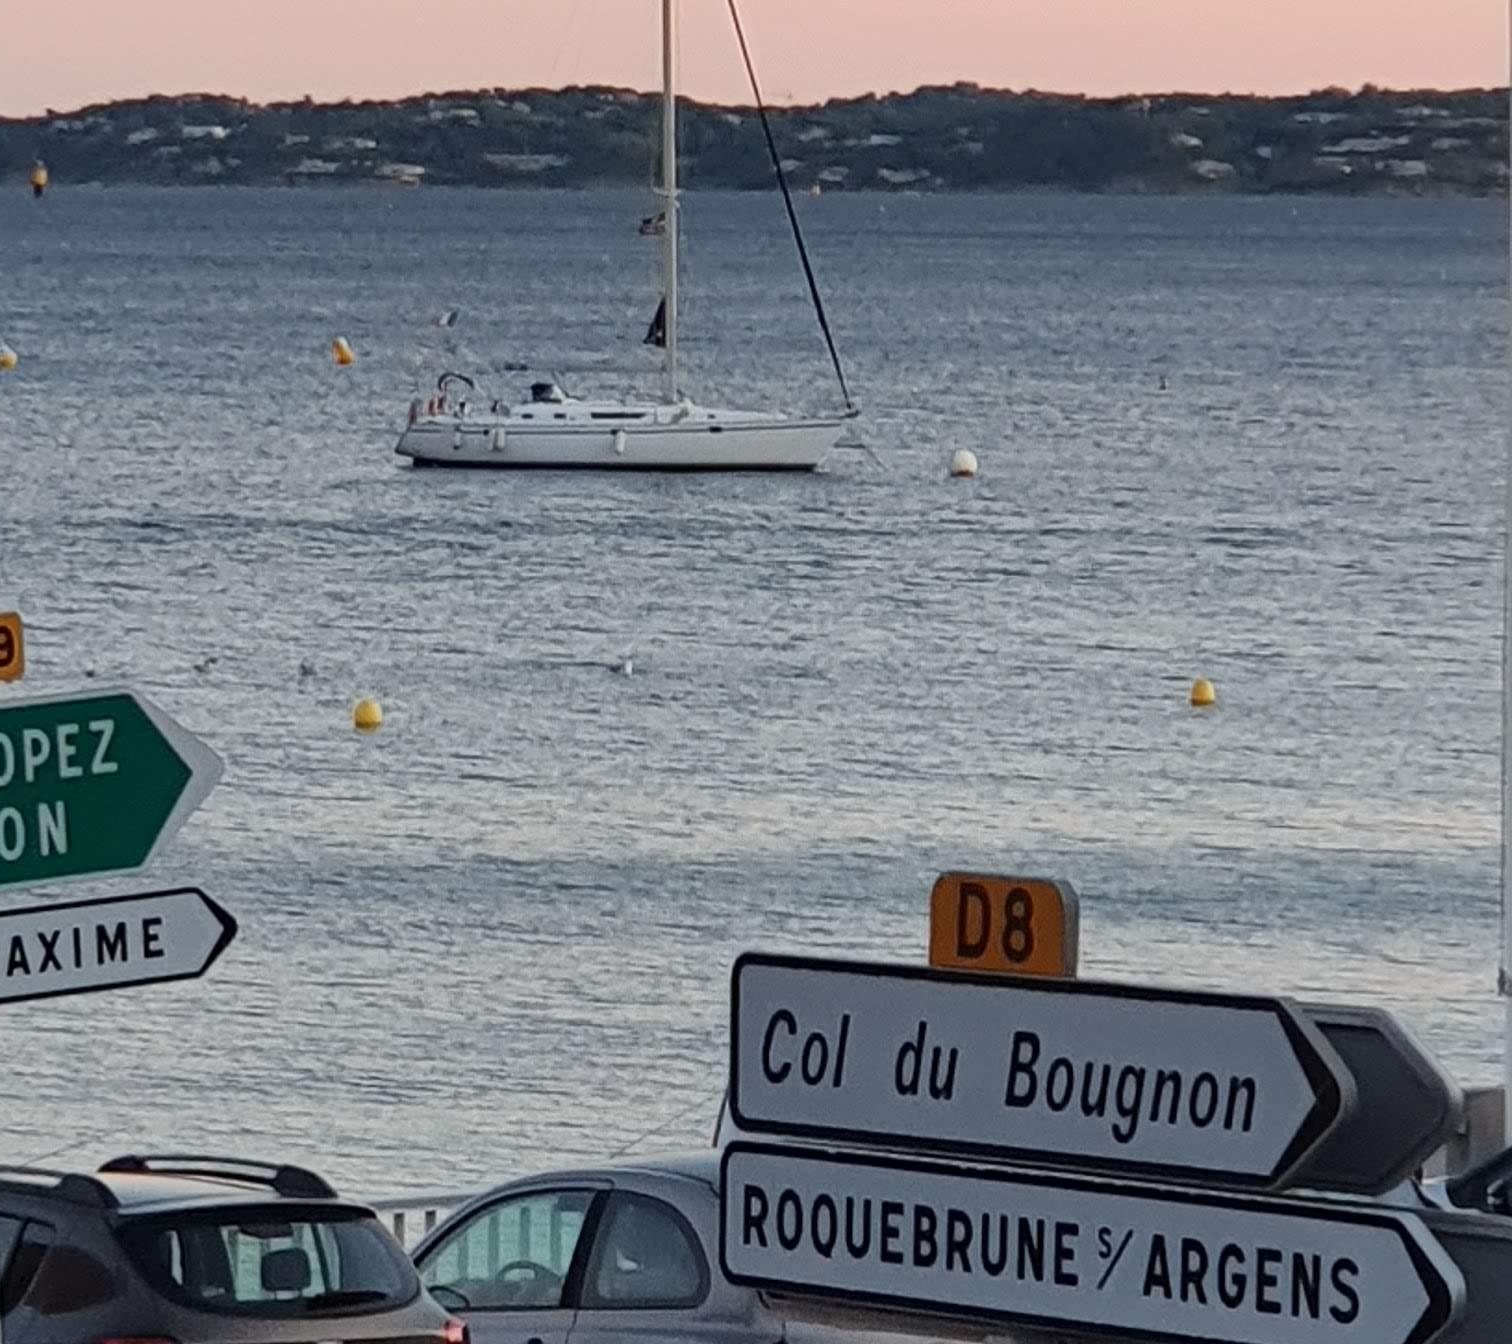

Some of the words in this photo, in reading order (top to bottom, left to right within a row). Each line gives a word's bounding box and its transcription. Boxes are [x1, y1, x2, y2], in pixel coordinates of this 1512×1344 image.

[956, 881, 1035, 963] D8
[762, 1008, 851, 1088] Col
[894, 1020, 959, 1101] du
[1005, 1029, 1258, 1144] Bougnon
[741, 1184, 1080, 1287] ROQUEBRUNE
